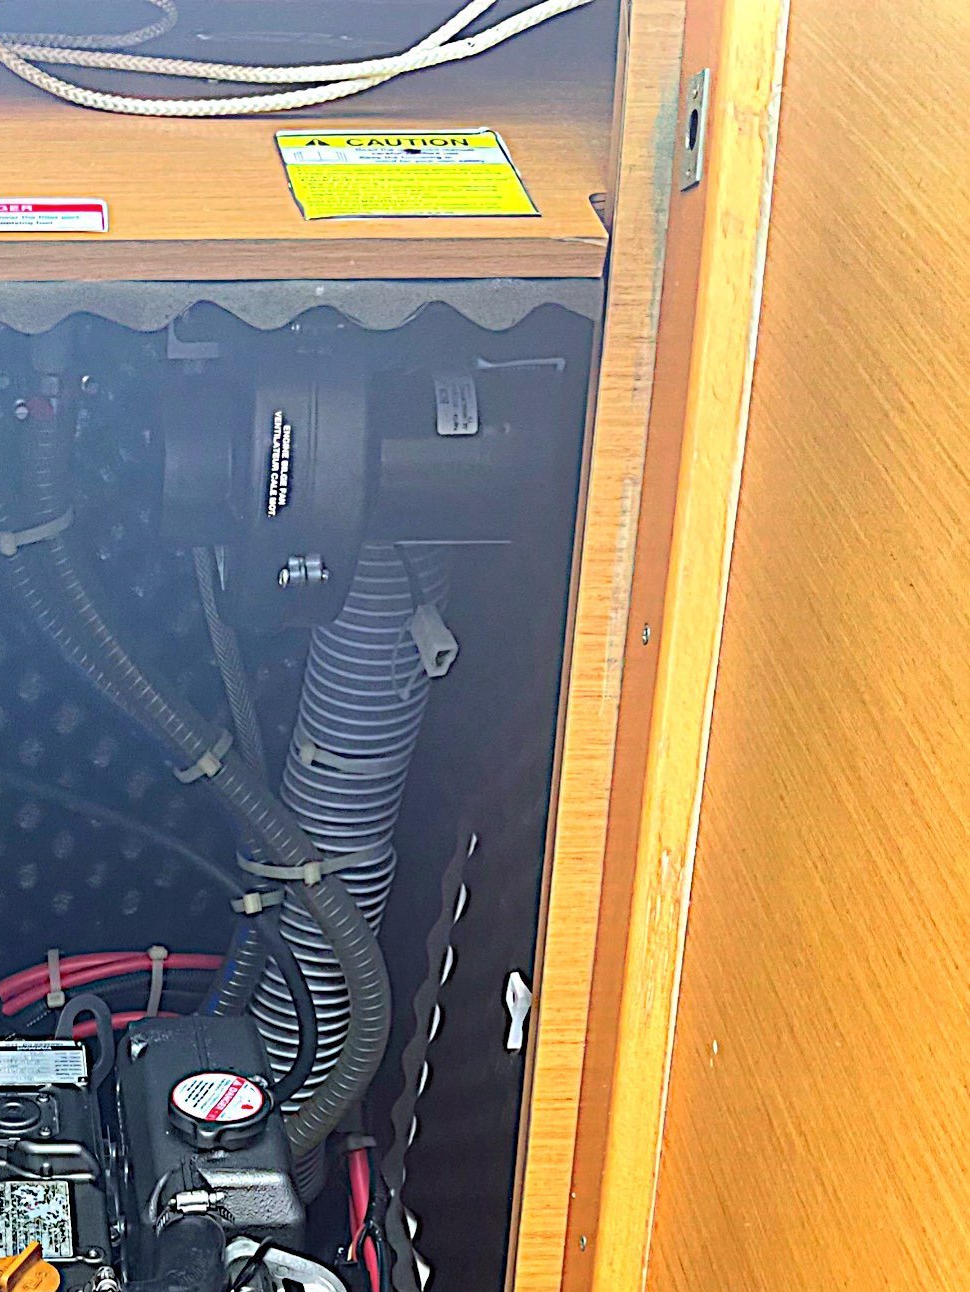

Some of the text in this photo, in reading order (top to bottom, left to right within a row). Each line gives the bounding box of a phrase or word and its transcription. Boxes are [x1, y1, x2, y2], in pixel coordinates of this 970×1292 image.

[346, 138, 469, 147] CAUTION
[271, 410, 282, 472] VENTILATEUR
[282, 424, 291, 459] ENGINE
